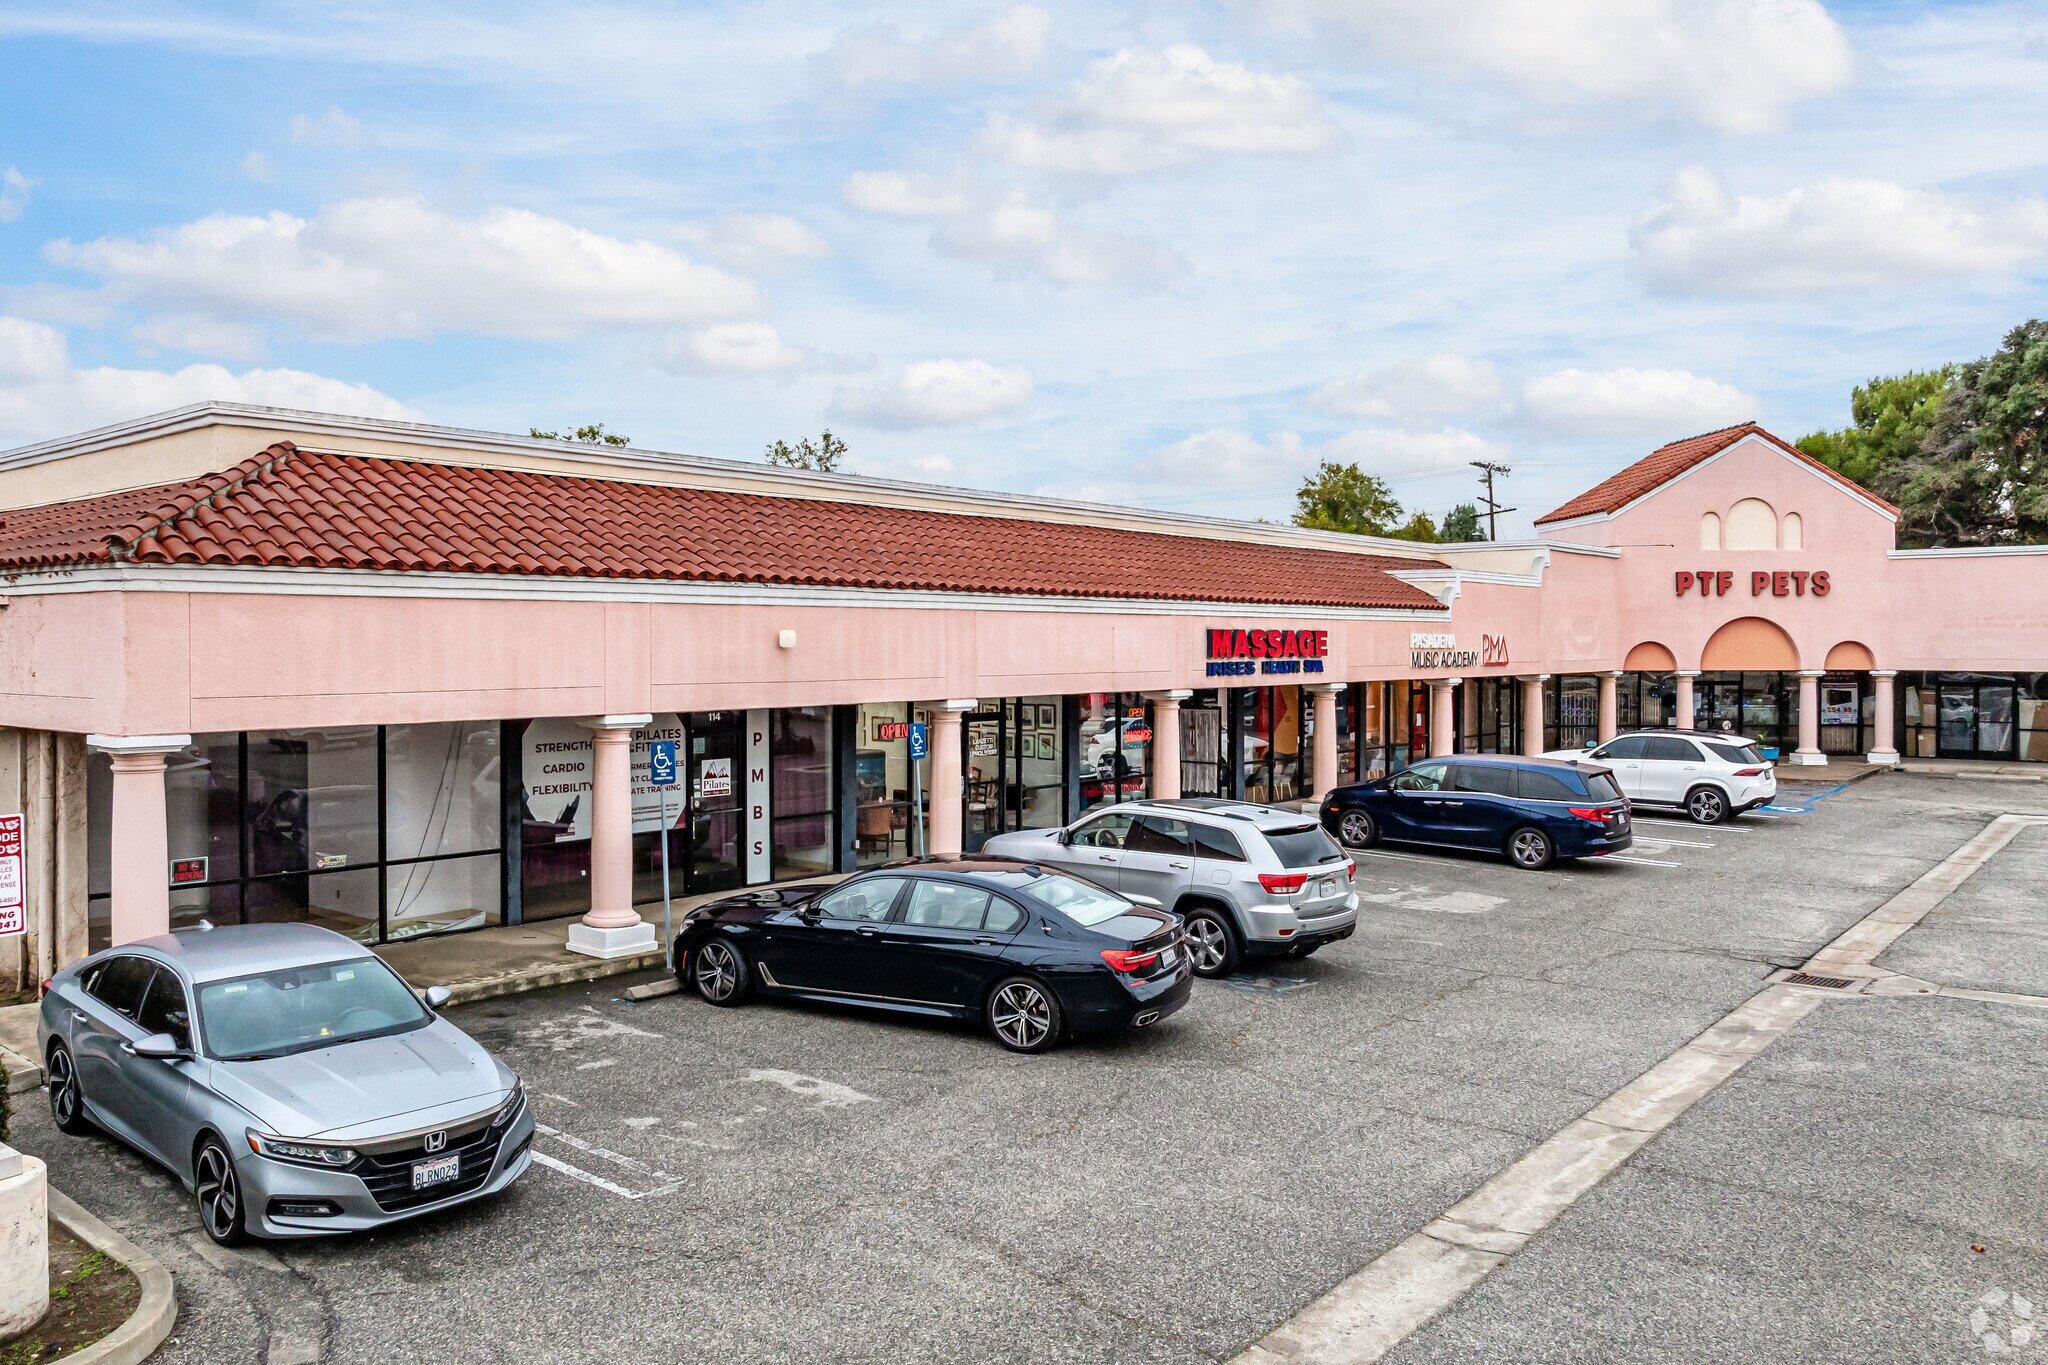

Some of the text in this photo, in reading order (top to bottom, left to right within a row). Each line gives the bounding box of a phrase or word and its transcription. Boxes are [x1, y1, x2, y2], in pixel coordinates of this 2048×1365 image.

[1676, 571, 1831, 596] PTF PETS
[1206, 629, 1328, 658] MASSAGE
[1410, 634, 1456, 648] PASADENA
[1411, 652, 1478, 668] MUSIC ACADEMY
[1206, 660, 1324, 676] IRISES HEALTH SPA
[708, 712, 720, 721] 114
[1129, 708, 1144, 716] OPEN
[636, 729, 681, 740] PILATES
[881, 724, 908, 739] OPEN
[535, 741, 592, 753] STRENGTH
[543, 762, 585, 774] CARDIO
[532, 782, 593, 795] FLEXIBILITY
[704, 780, 729, 789] Pilates
[416, 1163, 457, 1186] 8LRN029
